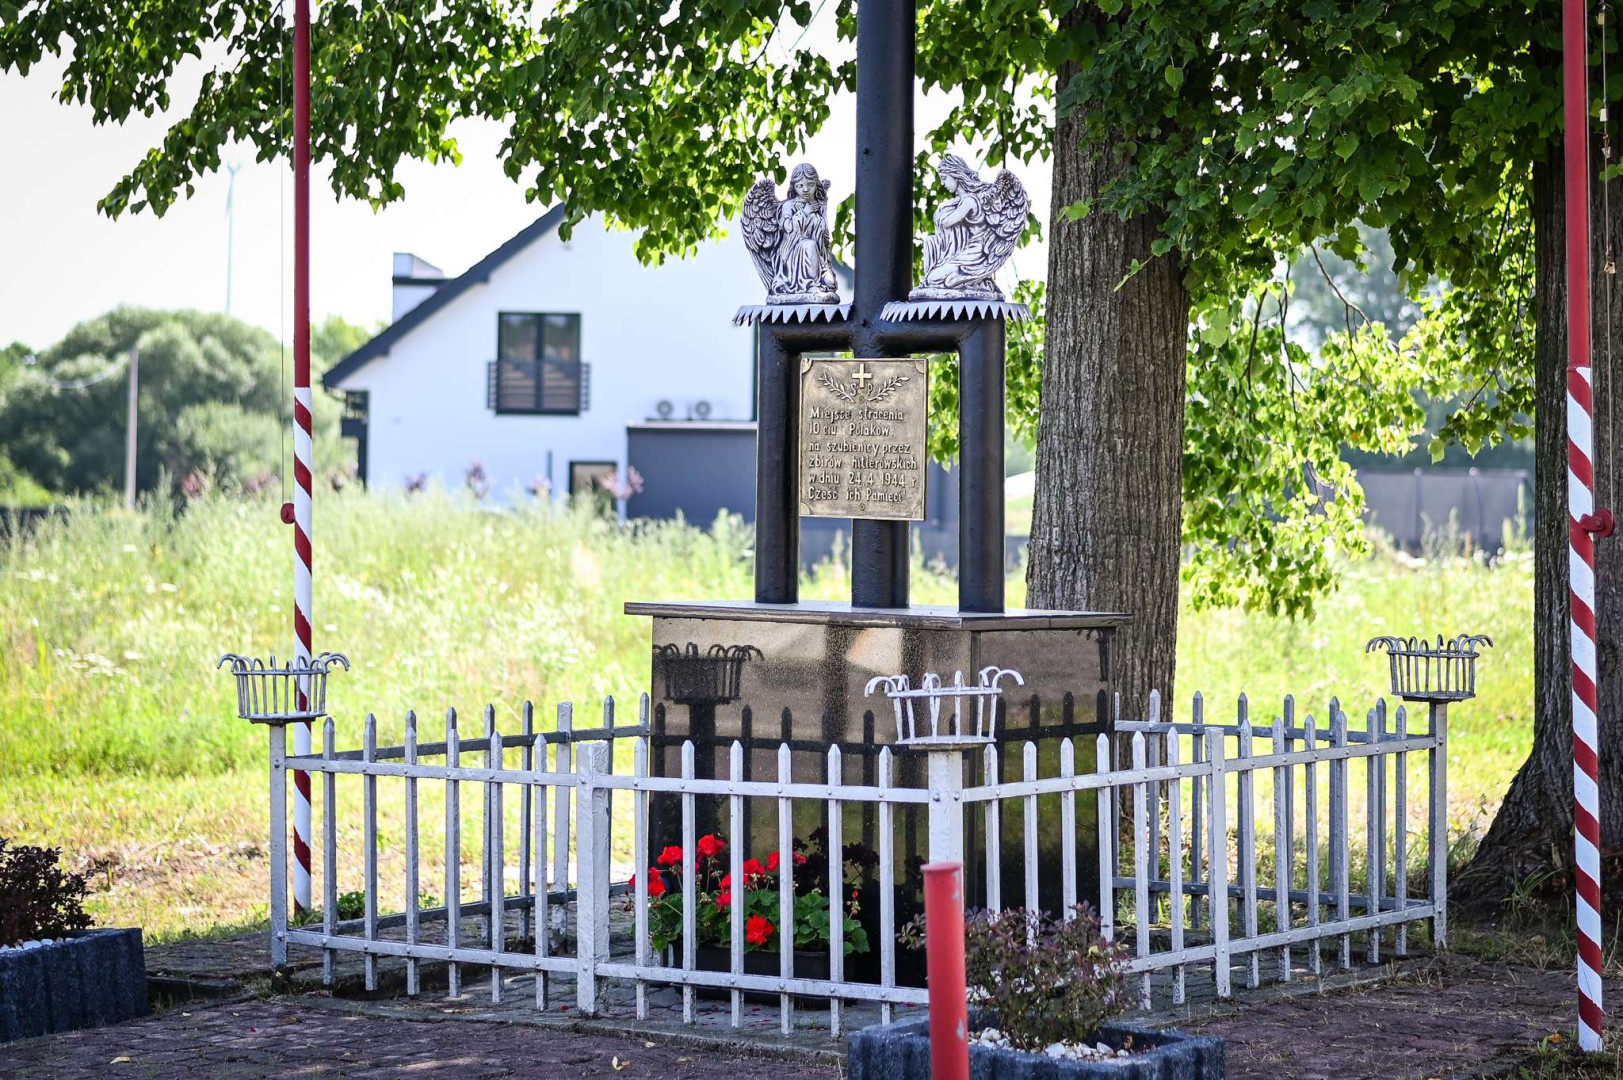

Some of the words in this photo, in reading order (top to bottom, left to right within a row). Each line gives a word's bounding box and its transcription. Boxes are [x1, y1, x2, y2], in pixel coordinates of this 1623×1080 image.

[811, 406, 852, 423] Miejsce
[858, 406, 904, 420] stracenia
[809, 441, 820, 451] na
[827, 440, 880, 456] szubienicy
[882, 443, 911, 457] przez
[852, 456, 917, 471] hitlerowskich
[808, 473, 816, 483] w
[819, 471, 840, 484] dniu
[845, 487, 861, 500] ich
